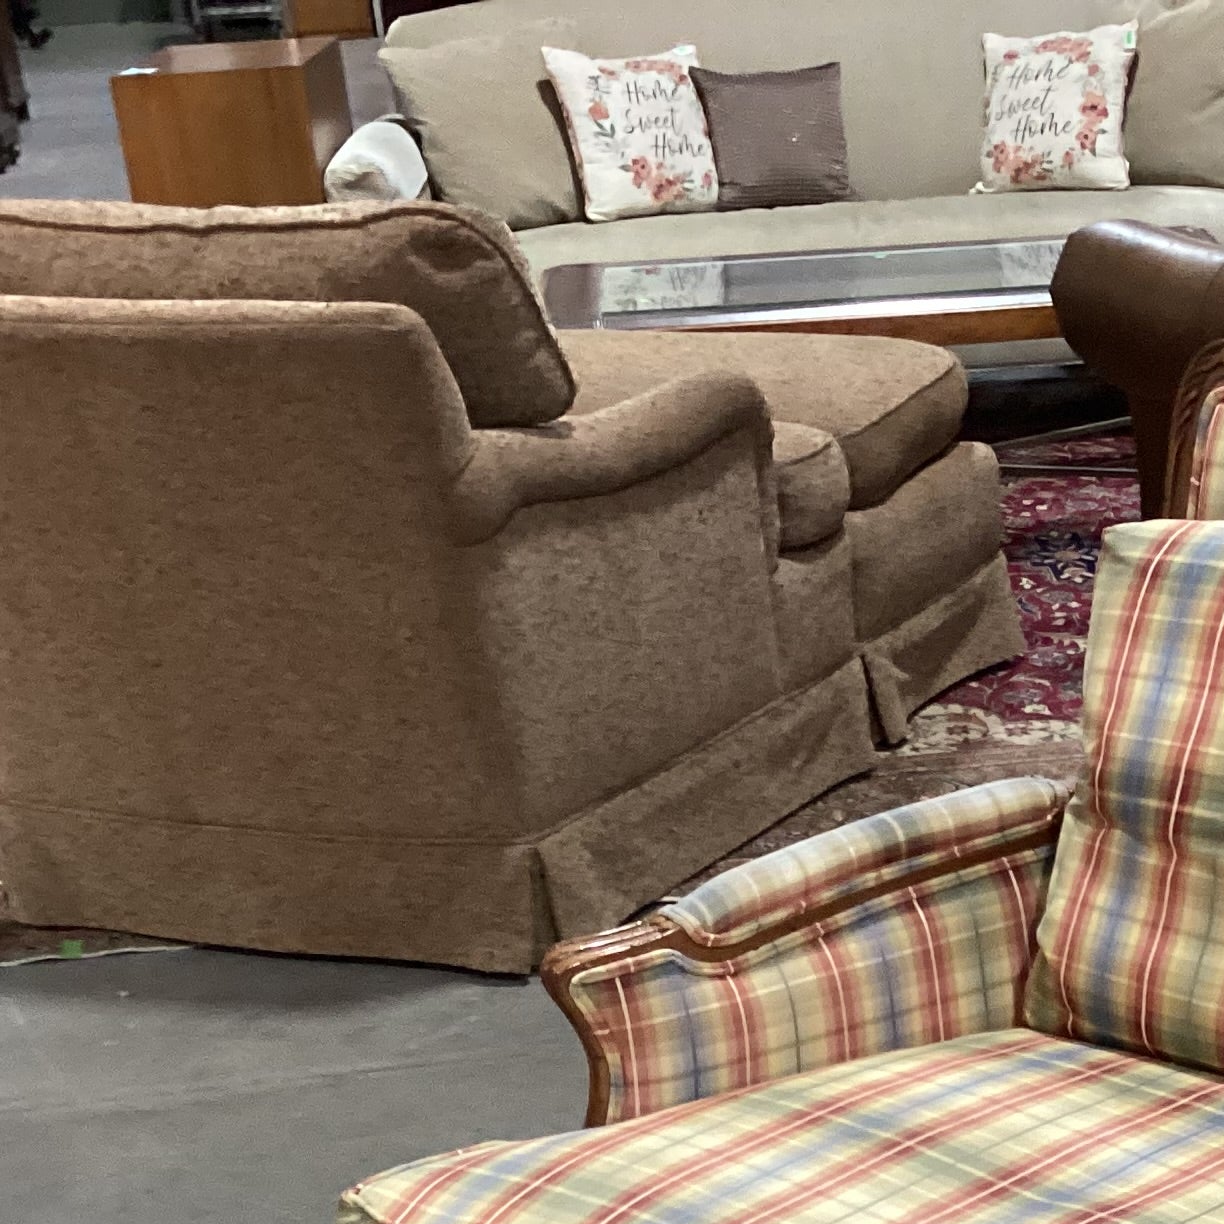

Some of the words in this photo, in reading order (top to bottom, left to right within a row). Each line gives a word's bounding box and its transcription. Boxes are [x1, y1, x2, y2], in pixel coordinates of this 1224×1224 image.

[1008, 57, 1073, 90] Home
[625, 80, 681, 104] Home
[624, 107, 682, 135] Sweet
[1010, 113, 1074, 143] Home
[650, 133, 706, 159] Home
